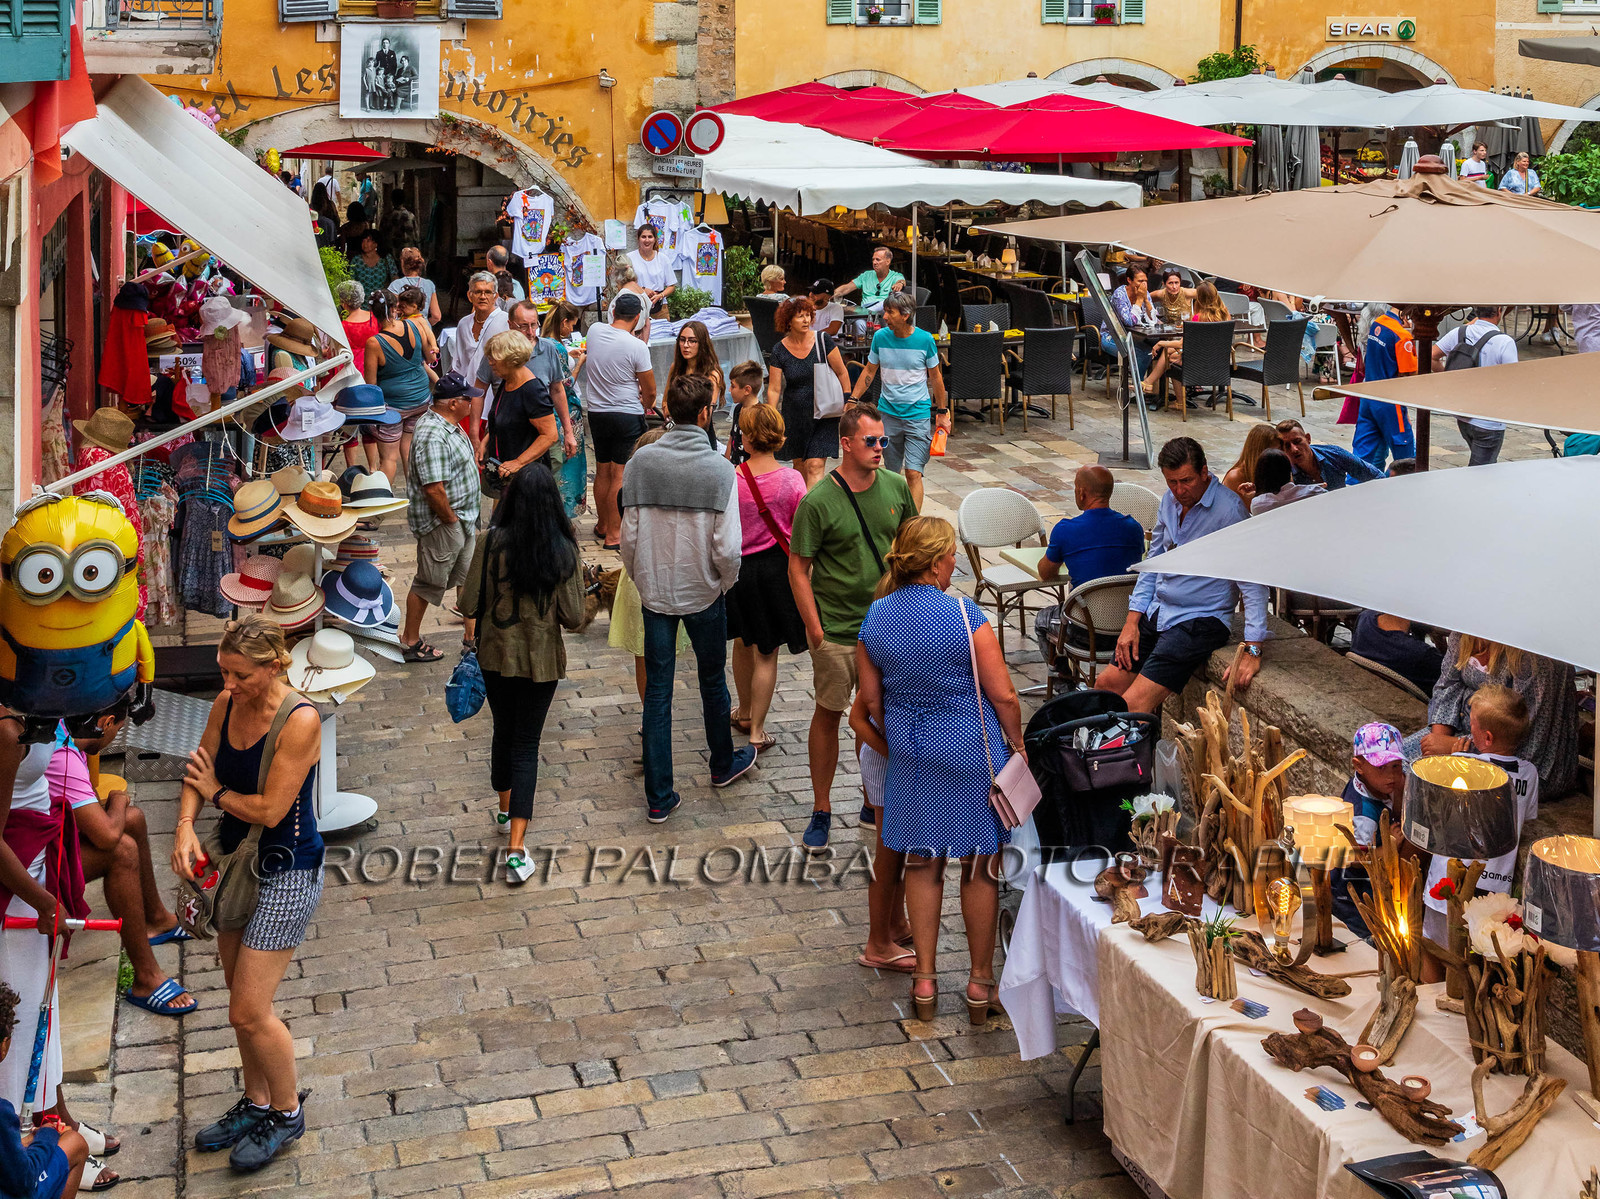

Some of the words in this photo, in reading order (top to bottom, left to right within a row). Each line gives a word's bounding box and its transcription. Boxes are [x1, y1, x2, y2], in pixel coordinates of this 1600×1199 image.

[1329, 22, 1392, 36] SPAR
[654, 156, 675, 165] PENDANT
[684, 160, 702, 168] HEURES
